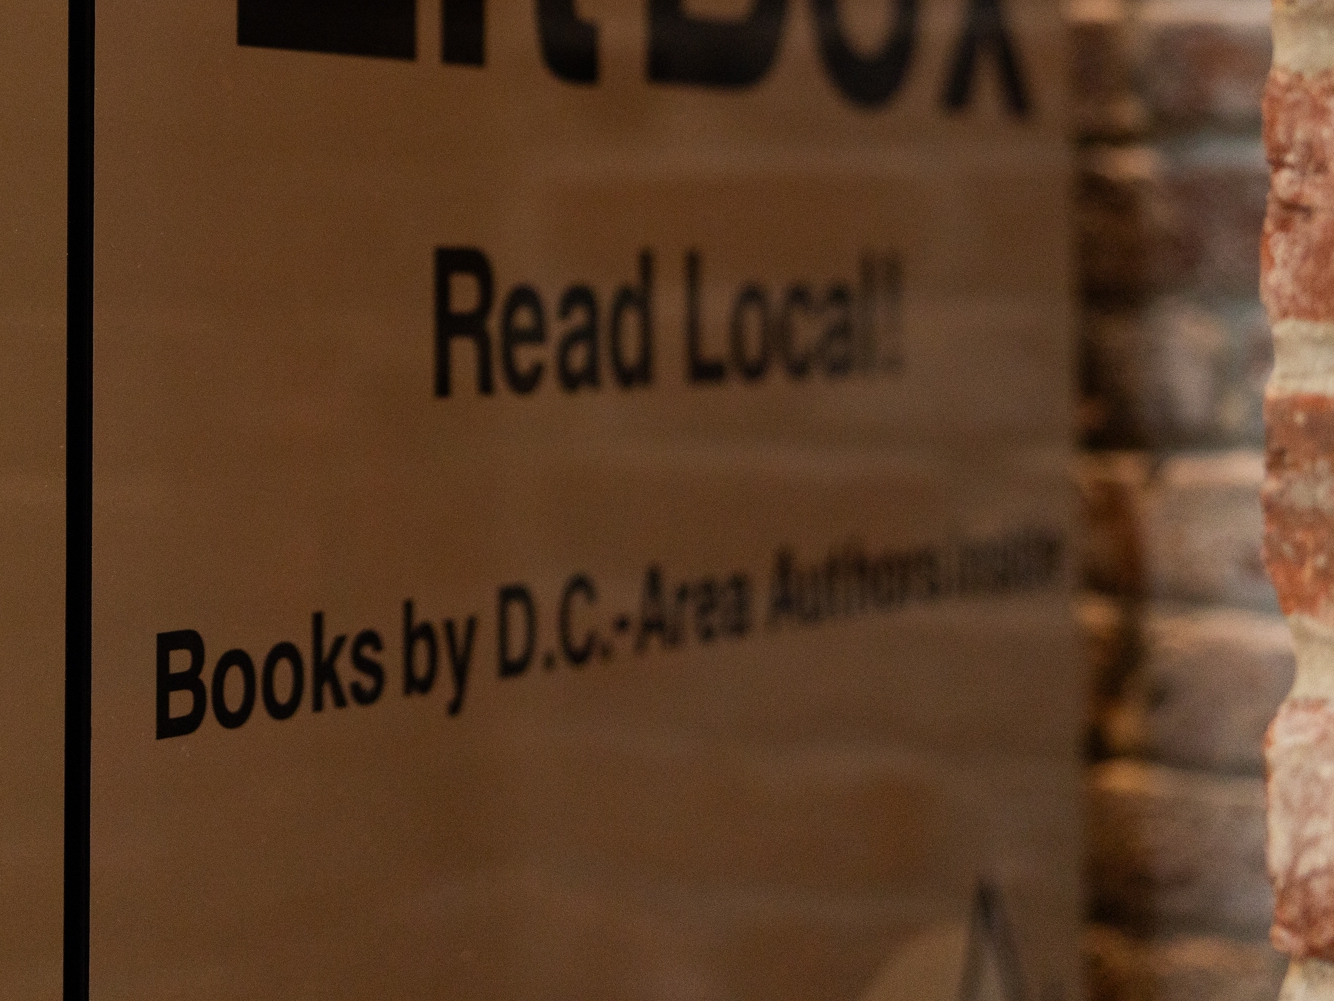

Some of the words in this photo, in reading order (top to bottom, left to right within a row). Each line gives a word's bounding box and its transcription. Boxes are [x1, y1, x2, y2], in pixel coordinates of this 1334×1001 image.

[434, 246, 655, 399] Read
[155, 611, 386, 741] Books
[403, 601, 478, 717] by
